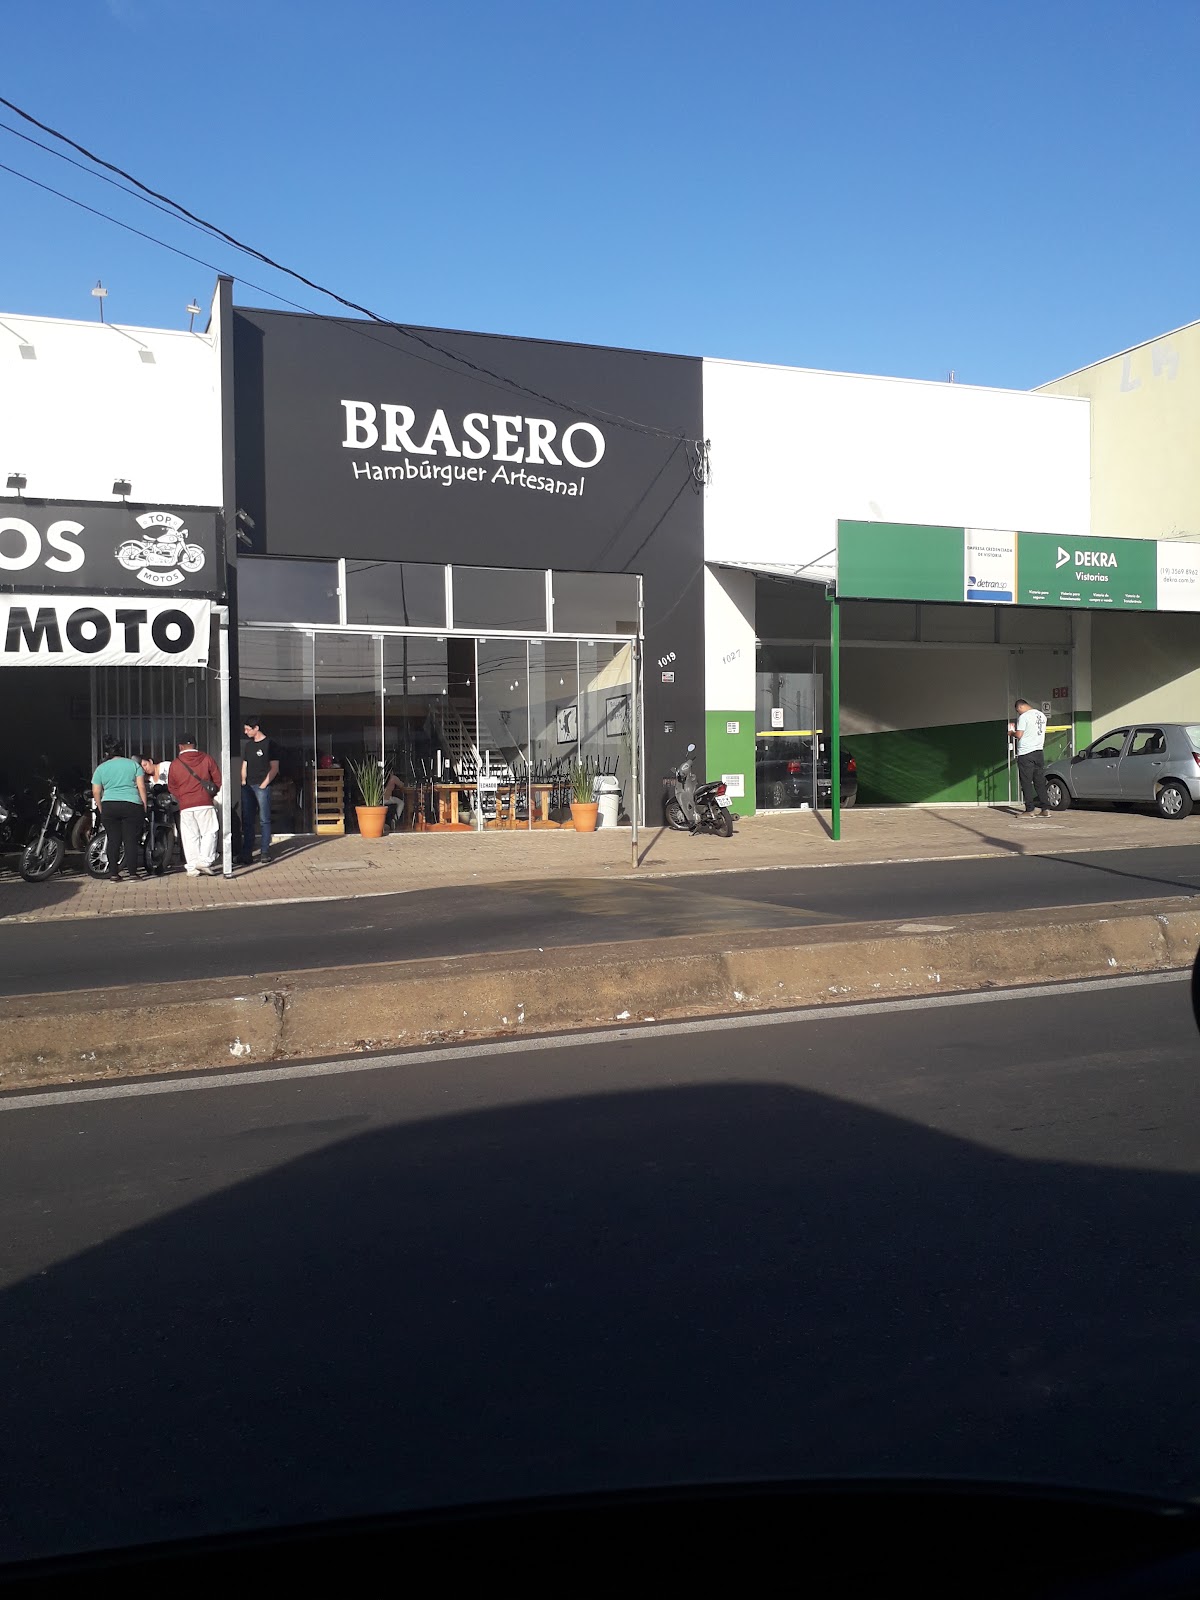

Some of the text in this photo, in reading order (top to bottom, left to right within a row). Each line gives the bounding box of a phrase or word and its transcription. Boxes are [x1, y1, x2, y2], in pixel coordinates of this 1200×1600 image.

[340, 399, 606, 468] BRASERO
[352, 458, 585, 496] Hambúrguer Artesanal
[148, 514, 172, 523] TOP
[1075, 551, 1118, 568] DEKRA
[143, 572, 179, 582] MOTOS
[1075, 571, 1109, 582] Vistorias
[1160, 567, 1170, 575] (19)
[4, 607, 195, 654] MOTO
[657, 652, 677, 667] 1019
[722, 648, 741, 664] 1027
